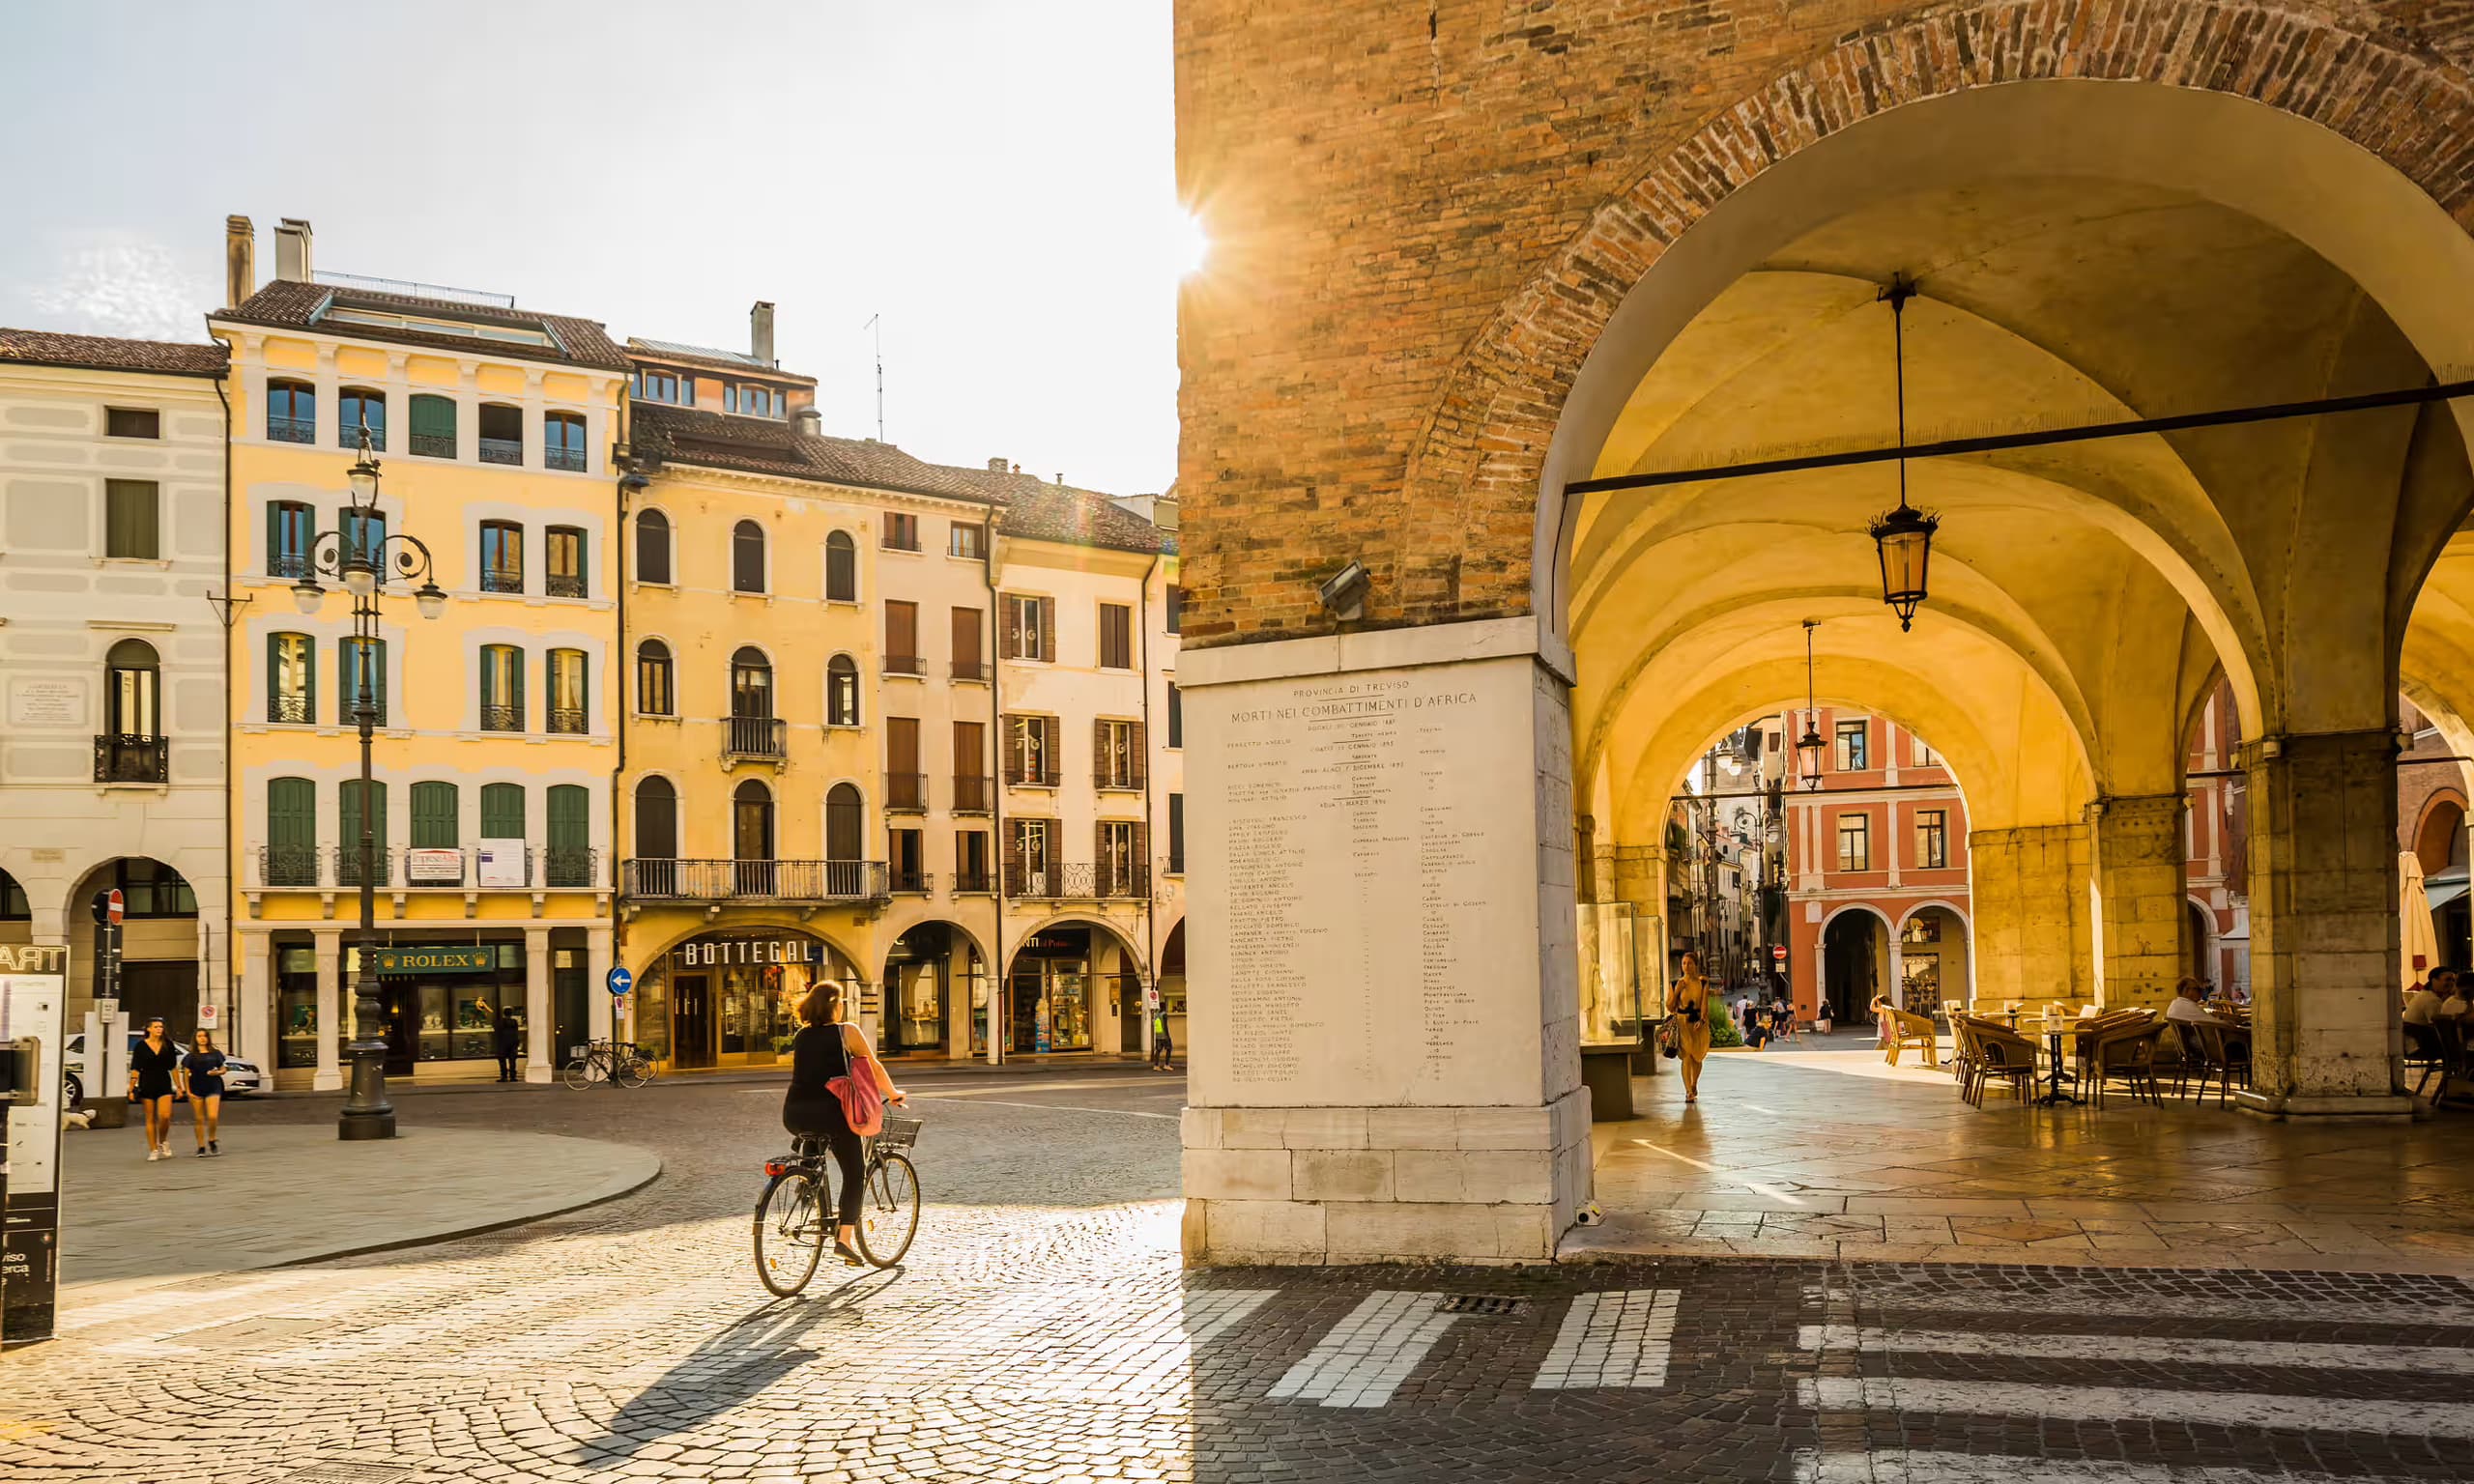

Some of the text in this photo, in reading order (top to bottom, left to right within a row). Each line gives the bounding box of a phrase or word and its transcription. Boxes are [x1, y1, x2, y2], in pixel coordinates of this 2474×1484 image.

[1294, 680, 1410, 698] PROVINCIA DI TREVISO
[1231, 693, 1478, 724] MORTI NEI COMBATTIMENTI D'AFRICA
[402, 955, 470, 967] ROLEX
[685, 941, 814, 965] BOTTEGAL
